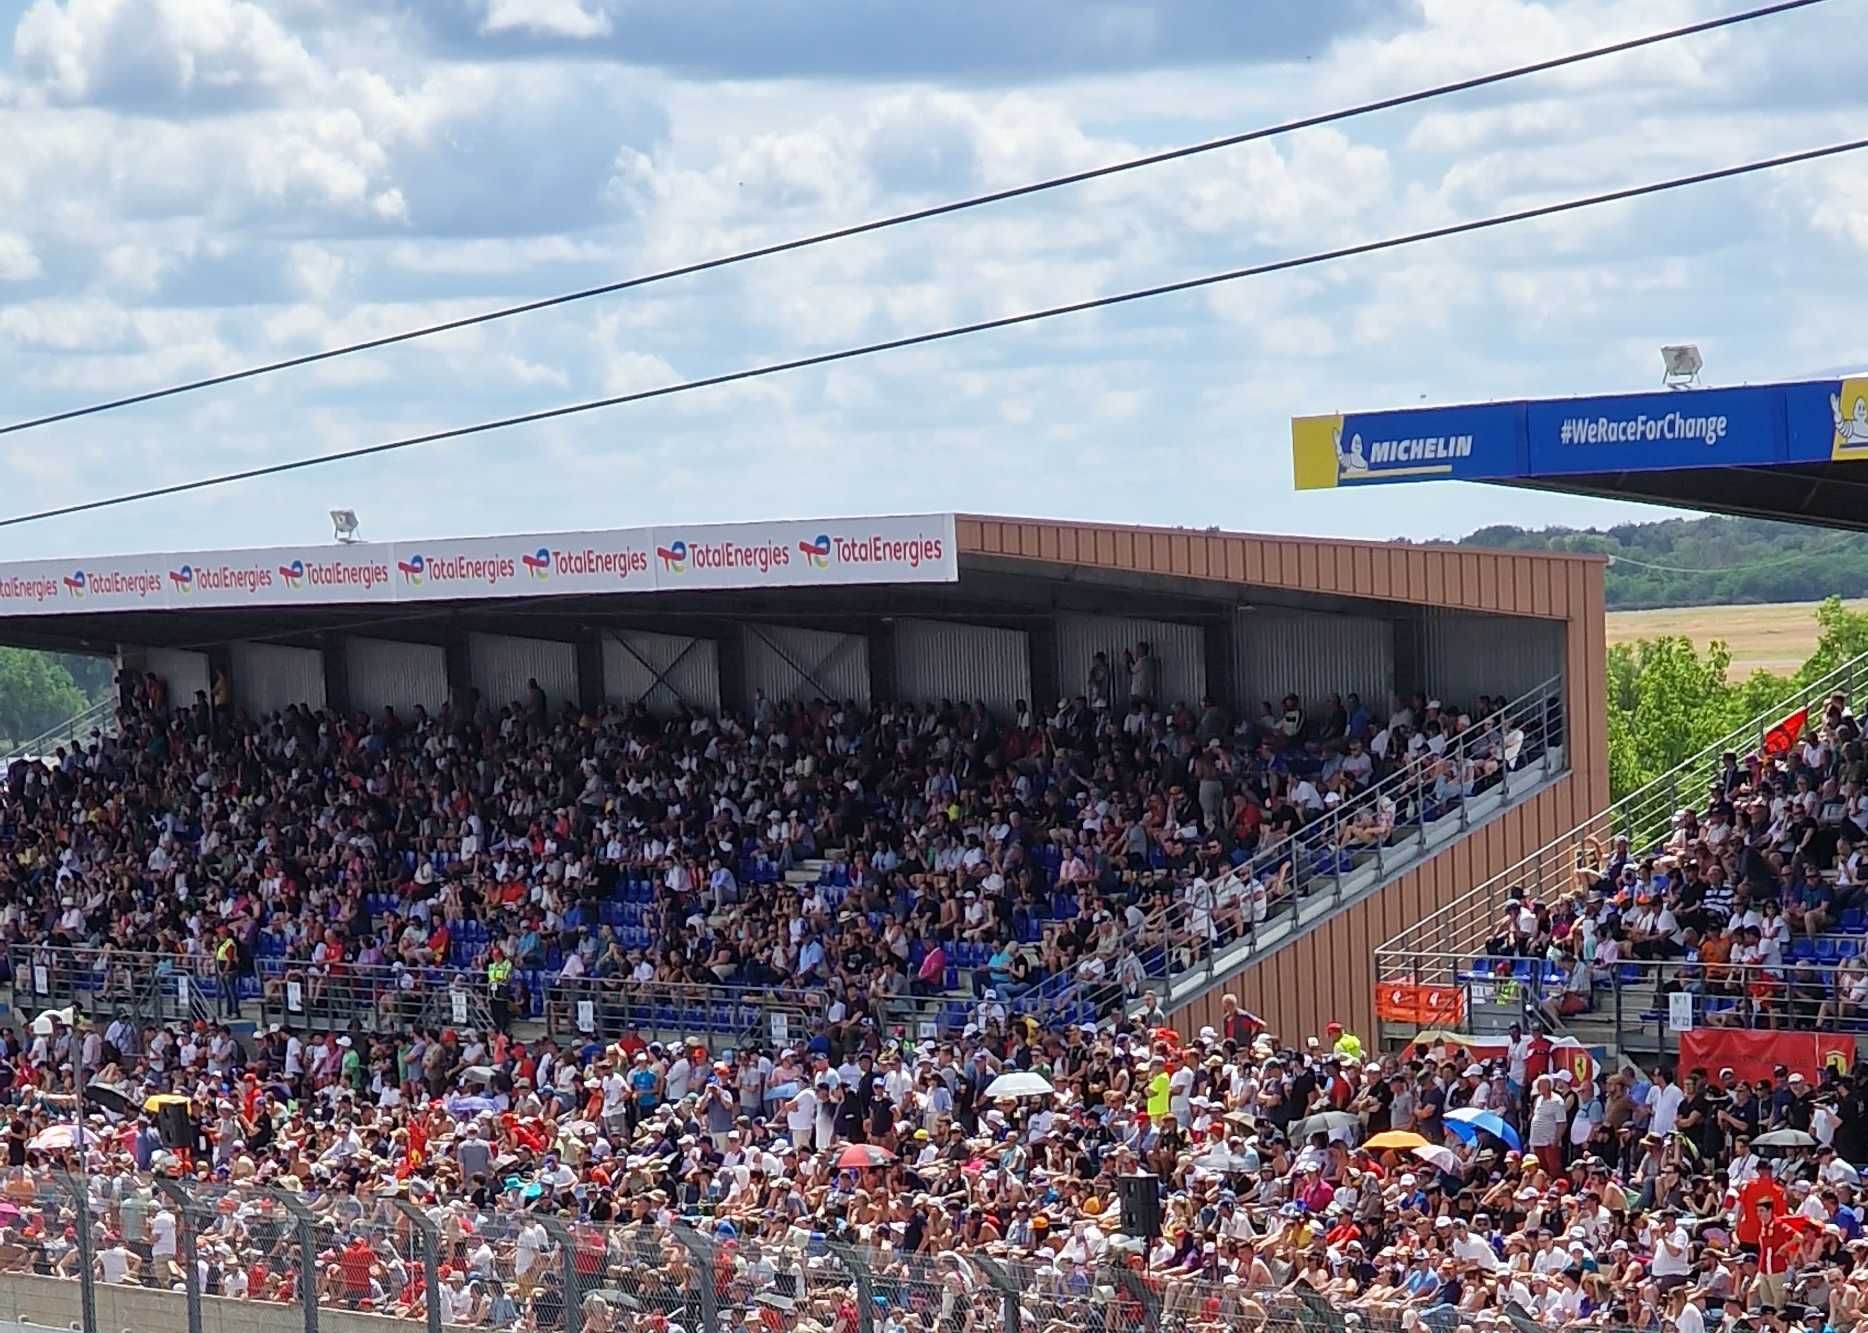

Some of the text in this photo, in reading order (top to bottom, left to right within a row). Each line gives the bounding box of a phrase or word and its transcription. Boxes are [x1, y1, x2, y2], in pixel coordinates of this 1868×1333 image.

[1561, 413, 1727, 446] #WeRaceForChange
[1370, 435, 1472, 463] MICHELIN
[552, 547, 648, 578] TotalEnergies
[689, 539, 790, 573] TotalEnergies
[834, 534, 942, 567] TotalEnergies
[194, 565, 272, 592] TotalEnergies
[305, 560, 388, 589] TotalEnergies
[426, 551, 515, 584] TotalEnergies
[87, 571, 161, 598] TotalEnergies
